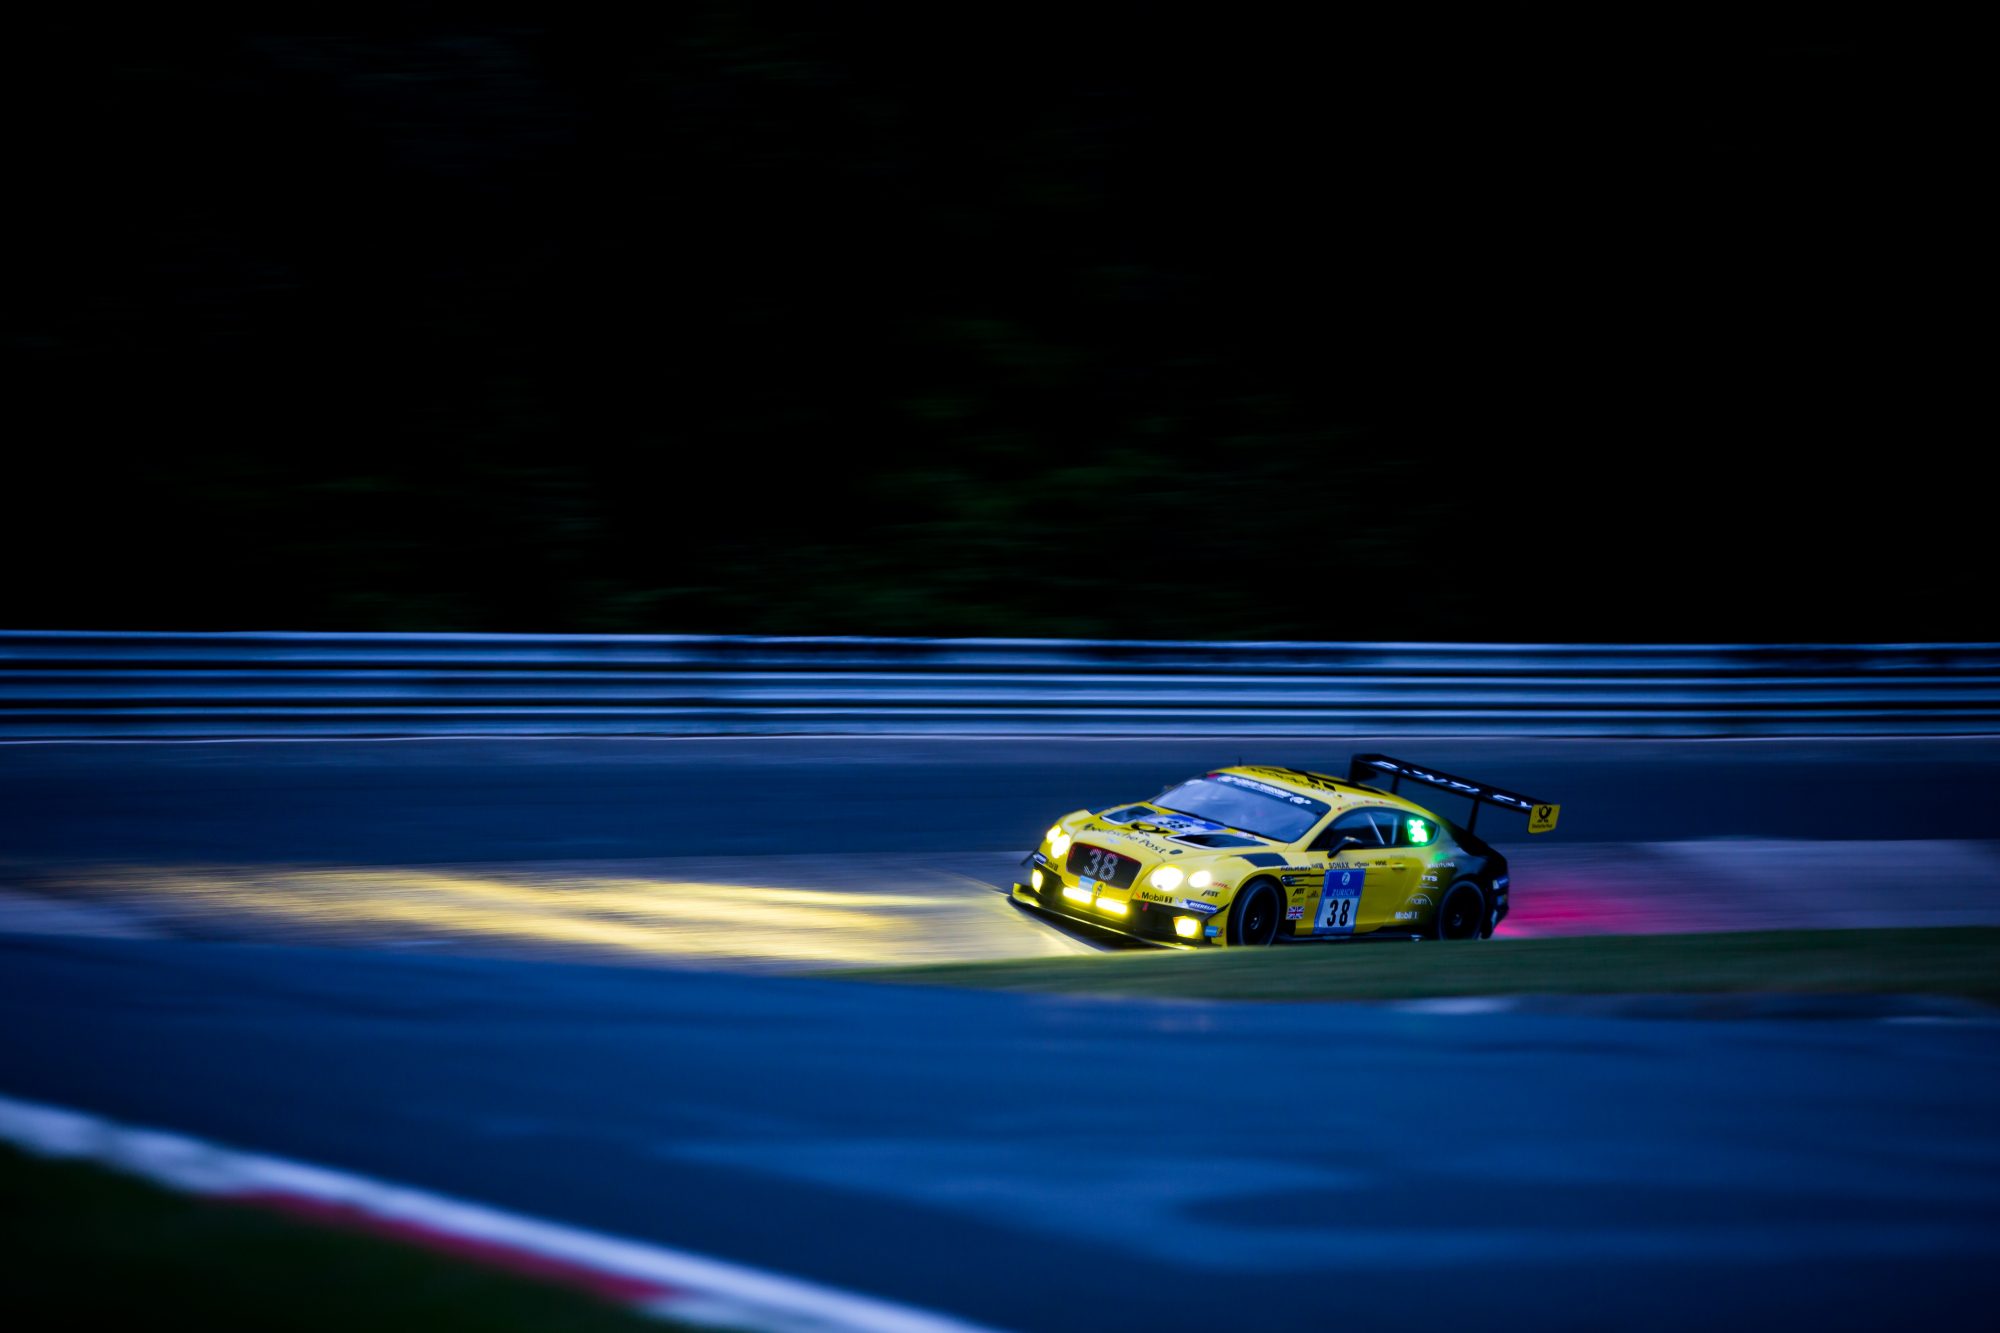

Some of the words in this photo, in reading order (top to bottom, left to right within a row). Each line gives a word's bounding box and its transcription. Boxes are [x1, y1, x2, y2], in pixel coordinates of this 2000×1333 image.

[1138, 838, 1166, 854] Post
[1083, 849, 1118, 881] 38
[1141, 891, 1164, 901] Mobil
[1331, 888, 1355, 896] ZURICH
[1326, 899, 1350, 927] 38
